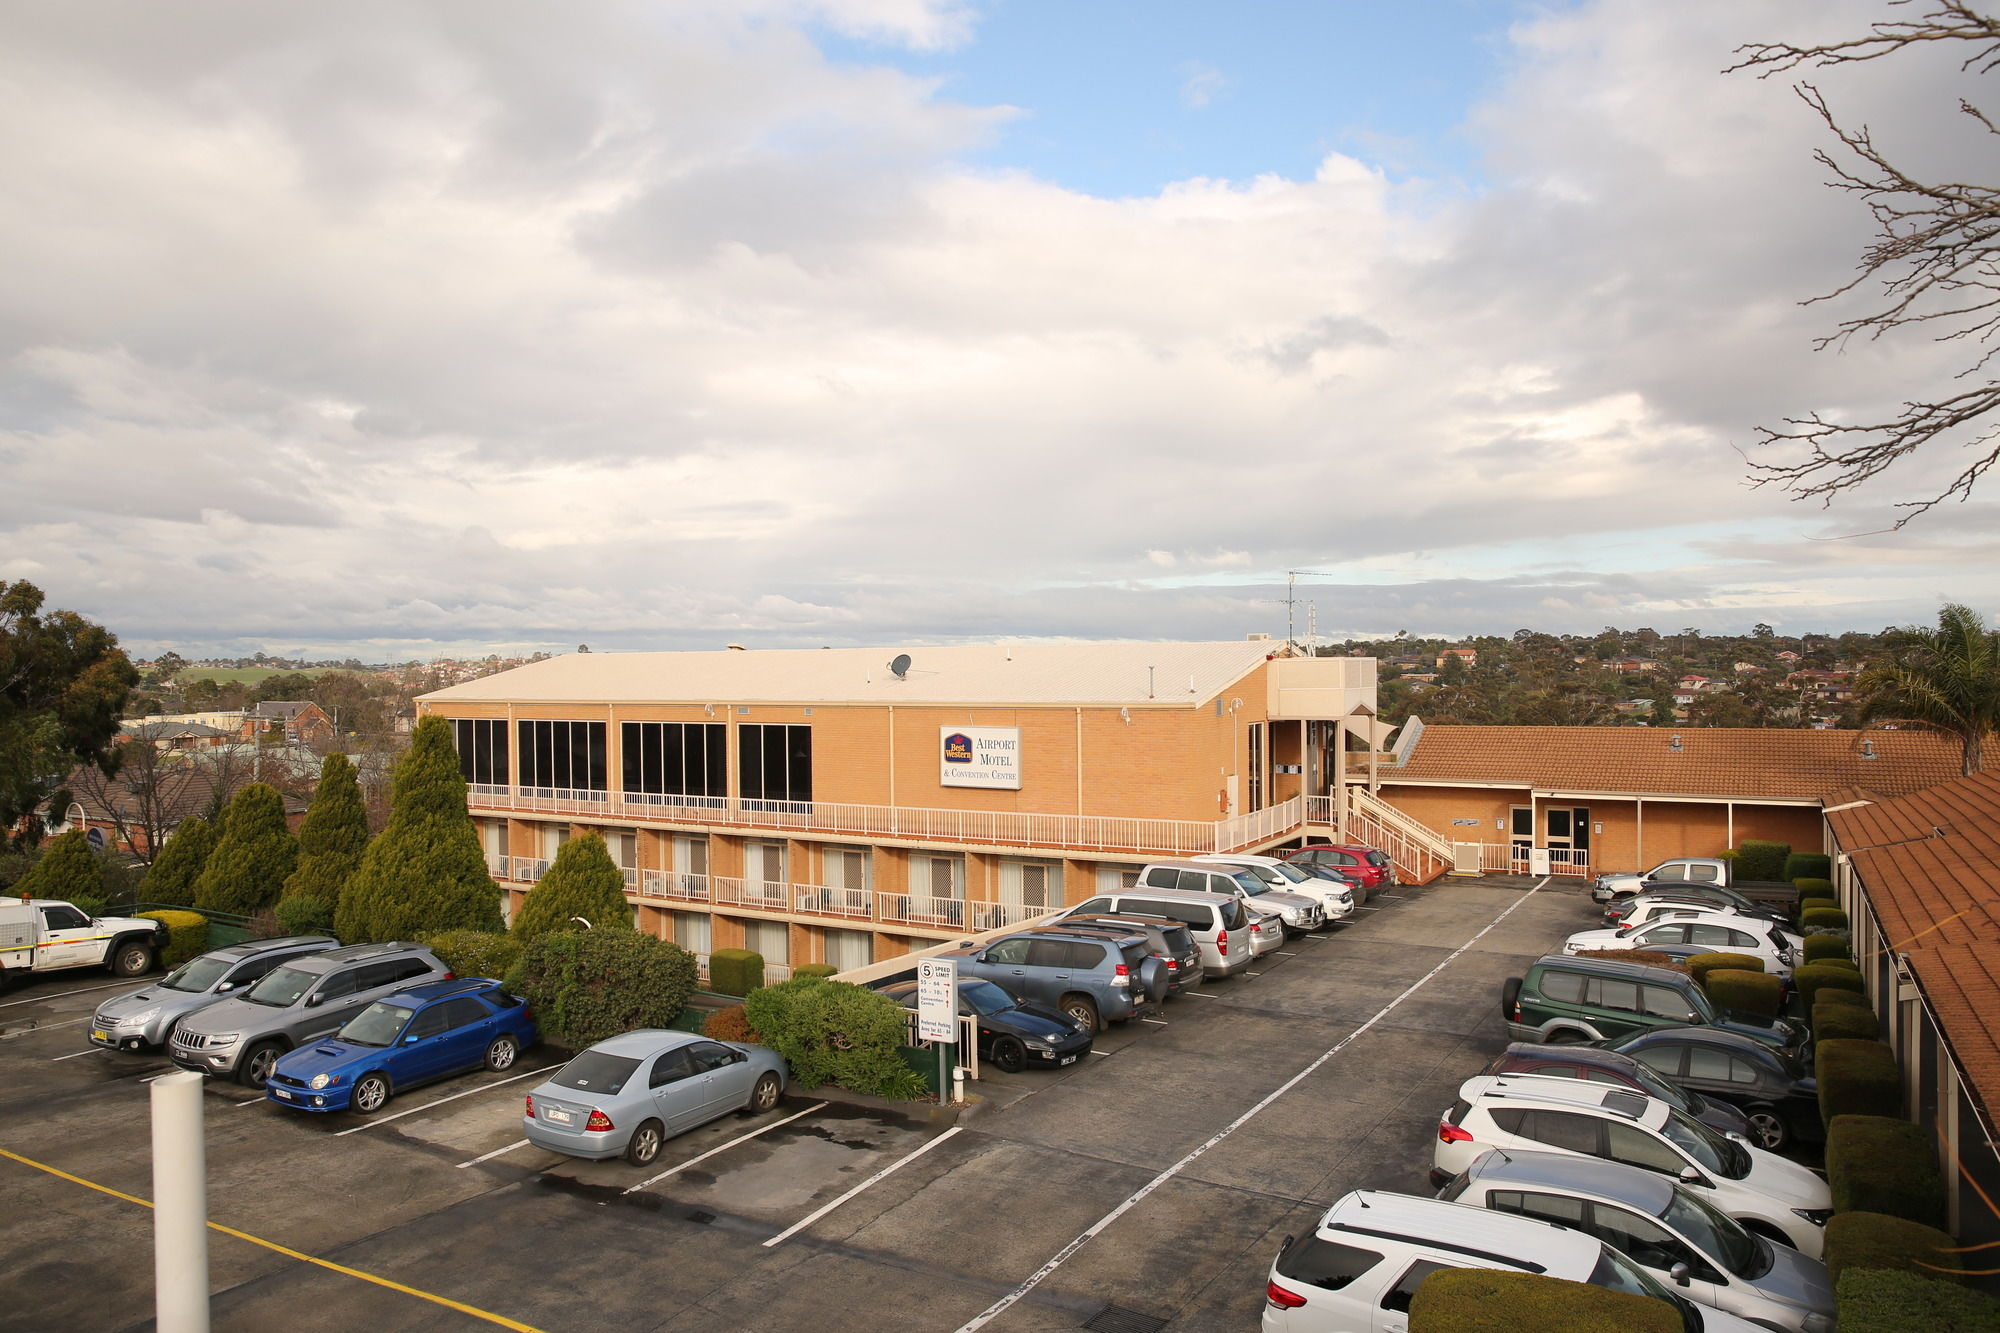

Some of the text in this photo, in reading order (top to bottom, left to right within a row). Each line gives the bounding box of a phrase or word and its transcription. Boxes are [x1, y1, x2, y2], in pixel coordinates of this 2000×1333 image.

[977, 738, 1016, 750] AIRPORT
[945, 750, 971, 758] Western
[981, 754, 1012, 766] MOTEL
[924, 966, 930, 976] 5
